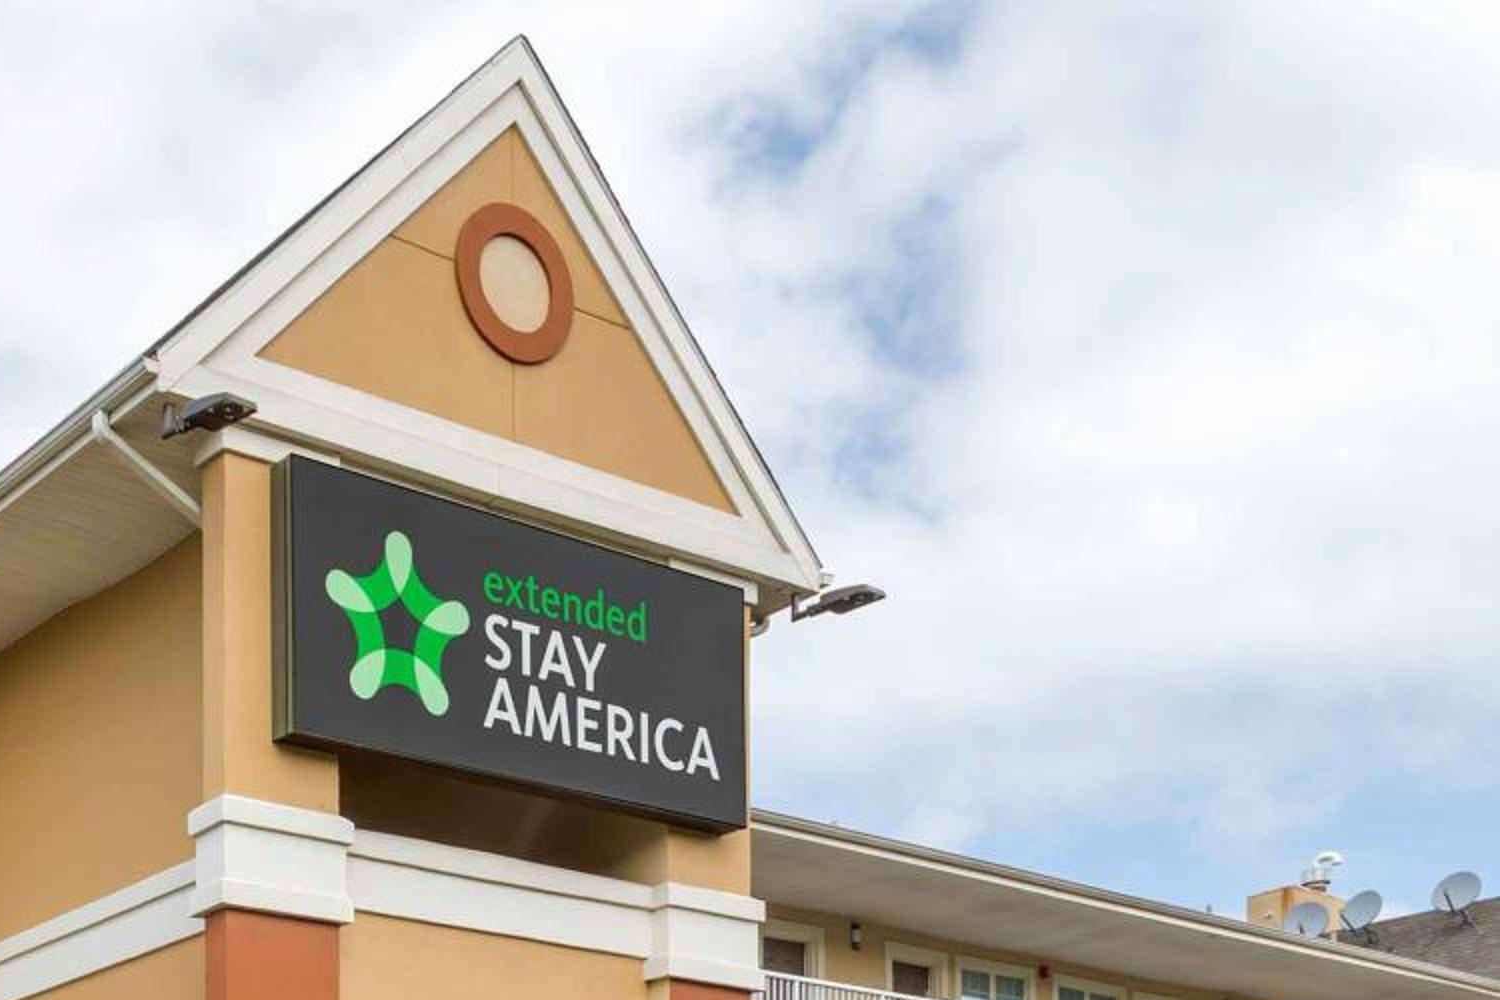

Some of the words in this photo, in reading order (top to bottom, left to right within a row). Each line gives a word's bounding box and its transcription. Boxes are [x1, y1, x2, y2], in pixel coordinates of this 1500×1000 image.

[483, 569, 648, 642] extended
[484, 613, 607, 692] STAY
[483, 677, 721, 781] AMERICA
